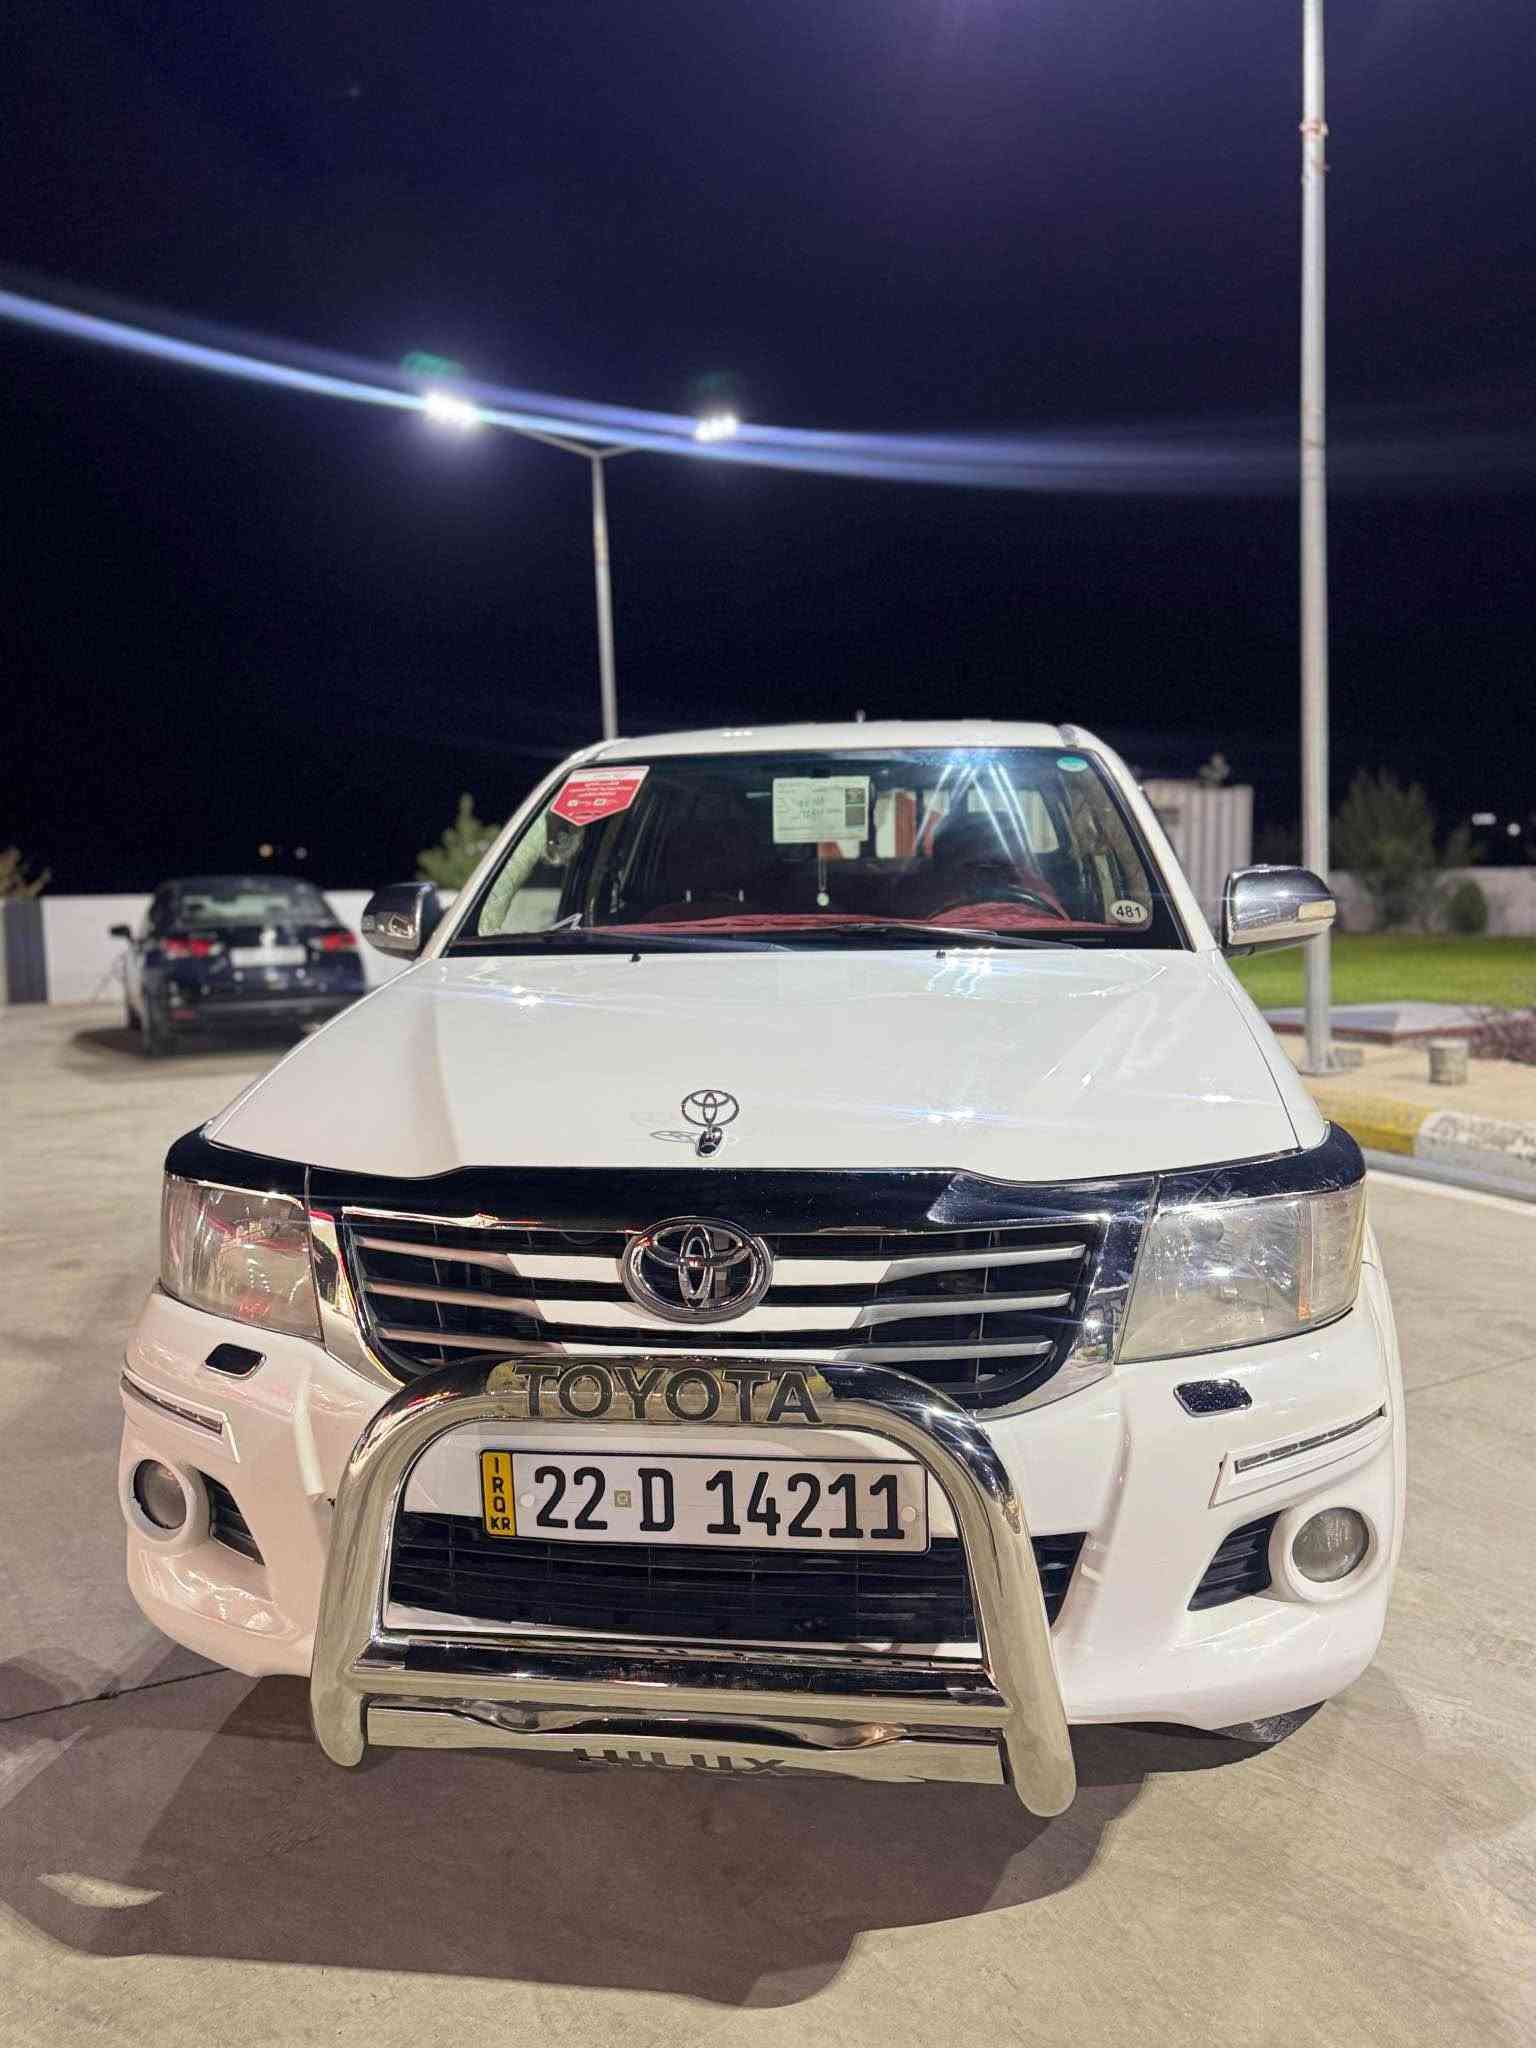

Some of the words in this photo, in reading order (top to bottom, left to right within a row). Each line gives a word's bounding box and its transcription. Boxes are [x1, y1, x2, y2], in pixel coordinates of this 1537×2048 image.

[1116, 905, 1141, 919] 481
[512, 1363, 823, 1424] TOYOTA
[534, 1465, 608, 1530] 22
[638, 1467, 675, 1532] D
[706, 1470, 905, 1539] 14211
[490, 1516, 511, 1530] KR
